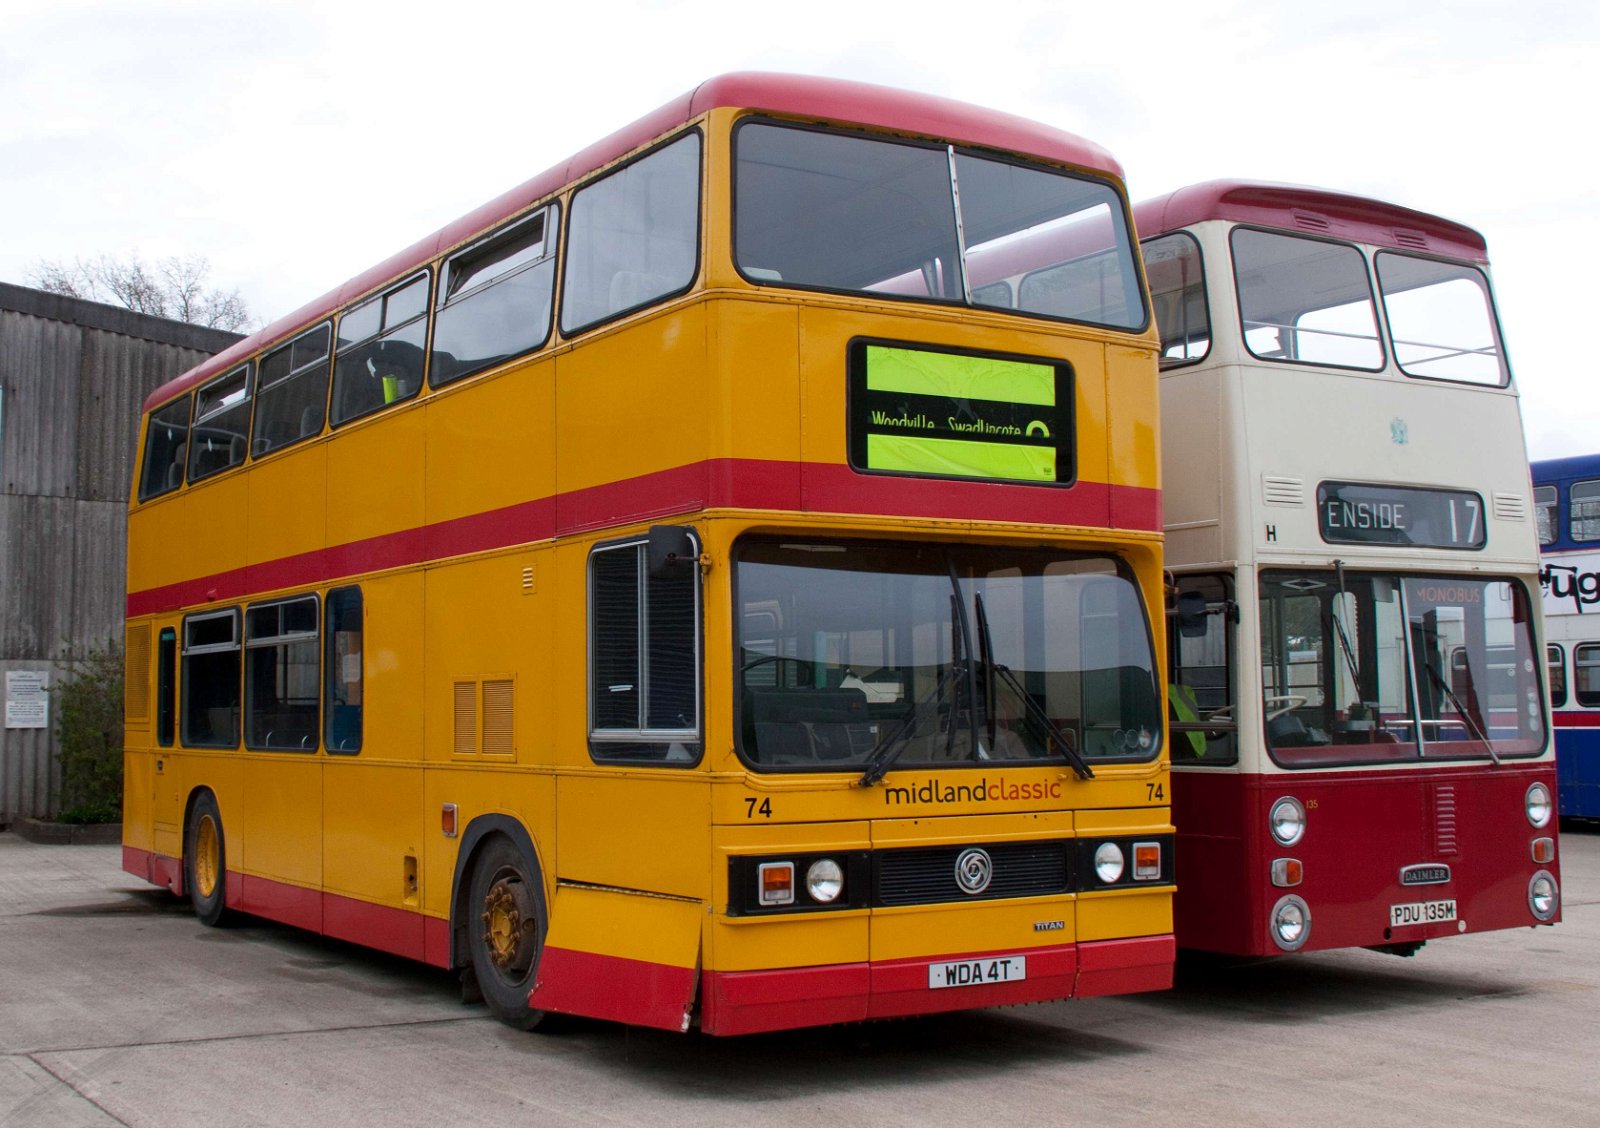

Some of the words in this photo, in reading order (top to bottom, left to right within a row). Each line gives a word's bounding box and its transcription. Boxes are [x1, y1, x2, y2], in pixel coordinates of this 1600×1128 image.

[1328, 501, 1405, 529] ENSIDE
[1450, 499, 1479, 544] 17
[1265, 524, 1276, 542] H
[1417, 586, 1480, 602] MONOBUS
[884, 778, 1062, 805] midlandclassic
[1147, 783, 1164, 802] 74
[744, 797, 772, 819] 74
[1306, 800, 1318, 809] 135
[1405, 869, 1446, 882] DAIMLER
[1395, 905, 1420, 925] PDU
[1424, 902, 1454, 921] 135M
[1036, 922, 1064, 931] TITAN
[944, 962, 984, 985] WDA
[988, 959, 1012, 981] 4T
